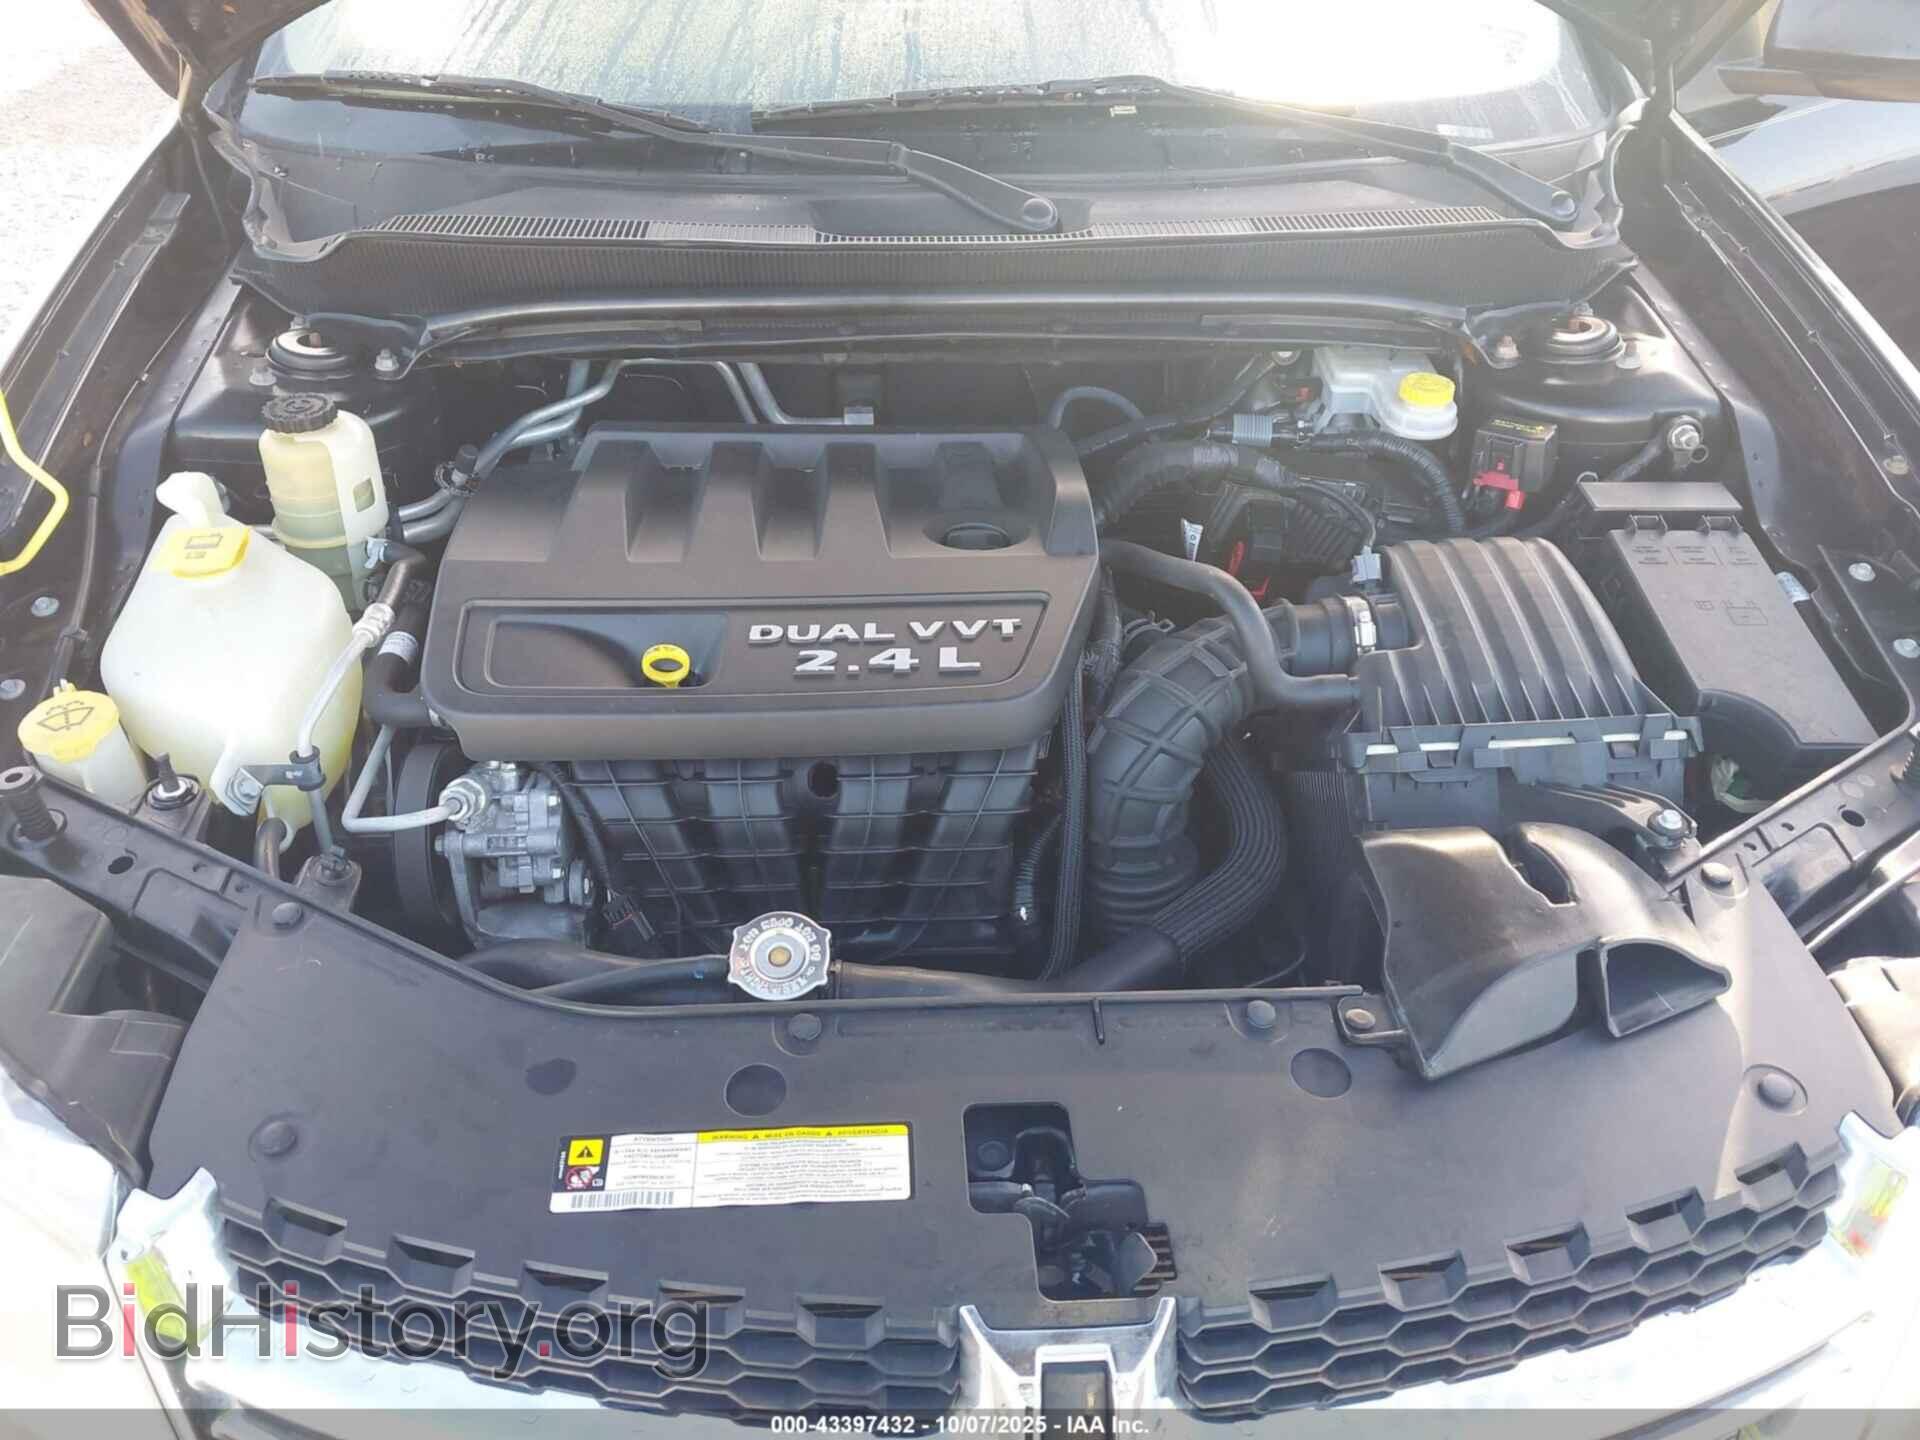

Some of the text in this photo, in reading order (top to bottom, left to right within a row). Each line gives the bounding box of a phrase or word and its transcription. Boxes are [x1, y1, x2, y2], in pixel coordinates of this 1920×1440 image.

[749, 618, 1021, 643] DUAL VVT
[794, 648, 920, 675] 2.4
